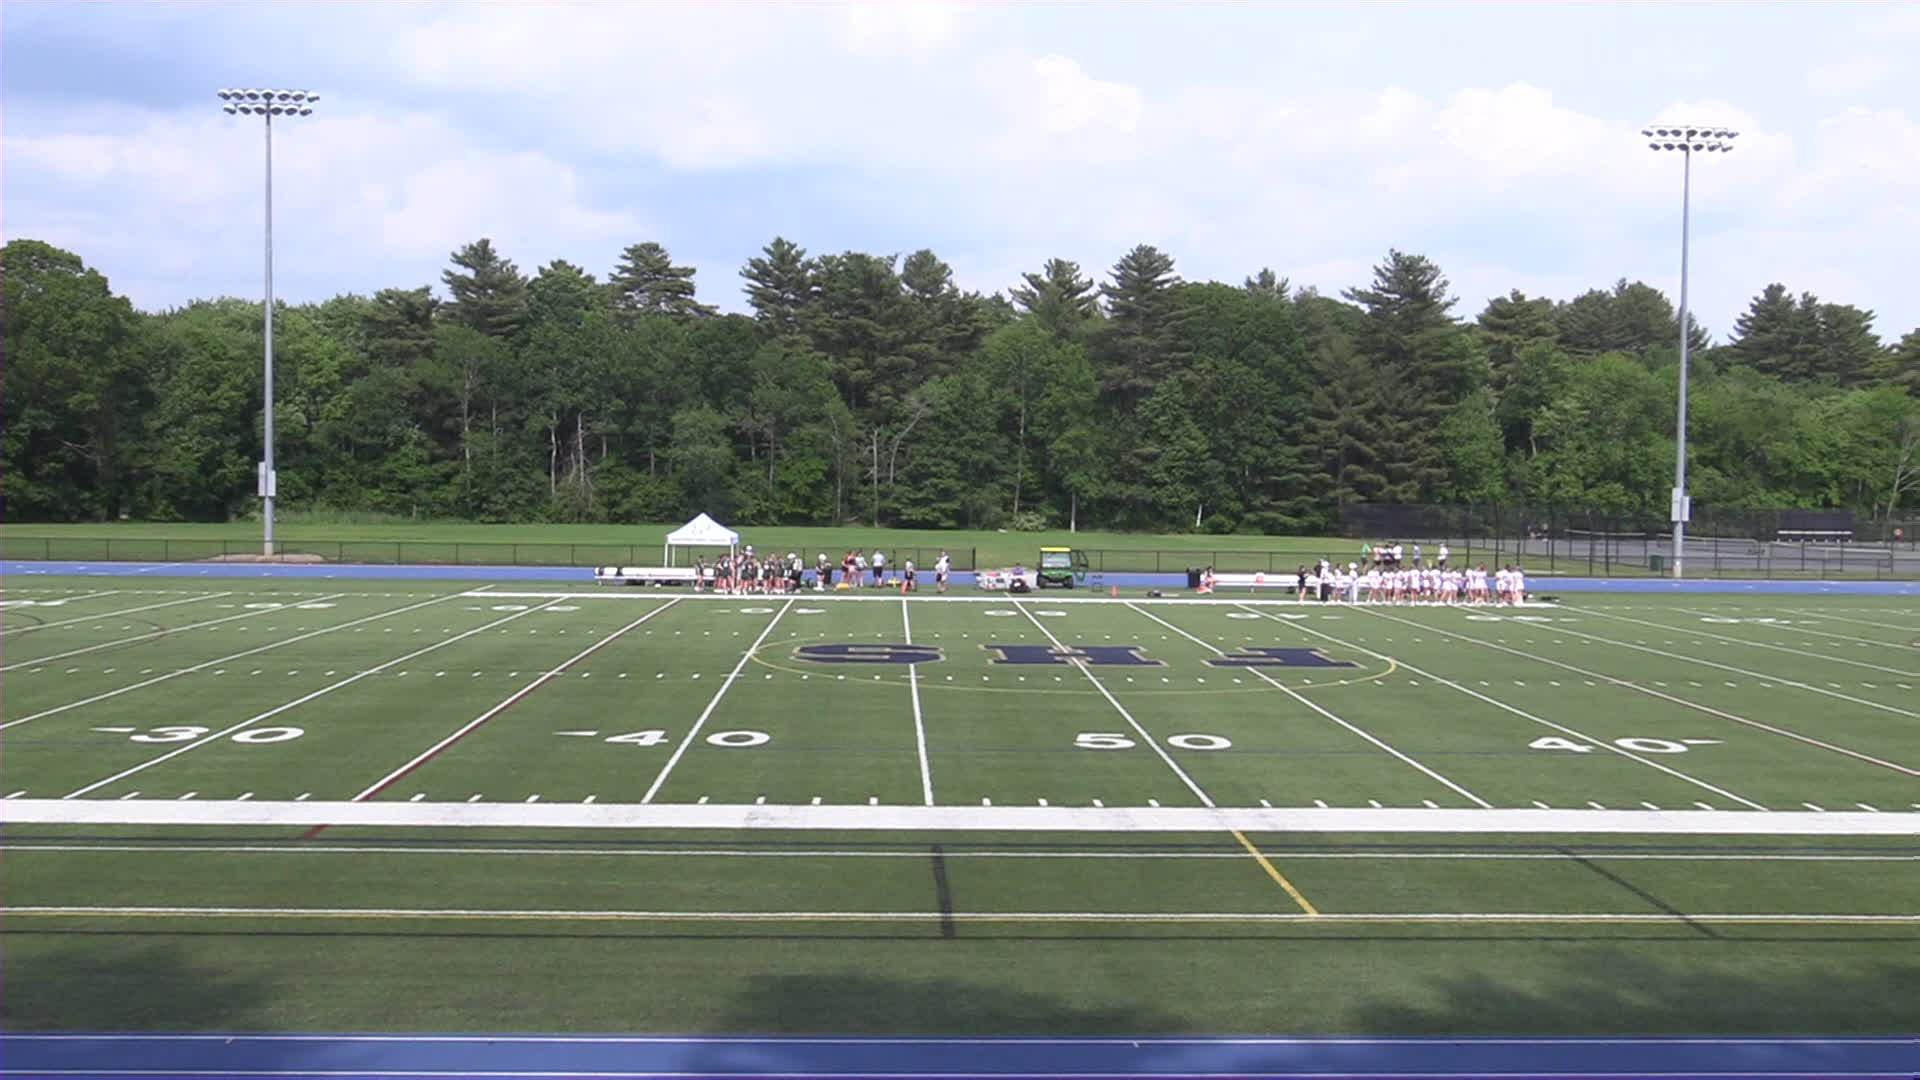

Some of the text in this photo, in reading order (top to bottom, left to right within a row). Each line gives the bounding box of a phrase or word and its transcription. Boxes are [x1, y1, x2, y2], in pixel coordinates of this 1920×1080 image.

[129, 725, 305, 744] 30
[604, 729, 770, 748] 40
[1074, 732, 1233, 751] 50
[1528, 735, 1688, 754] 40
